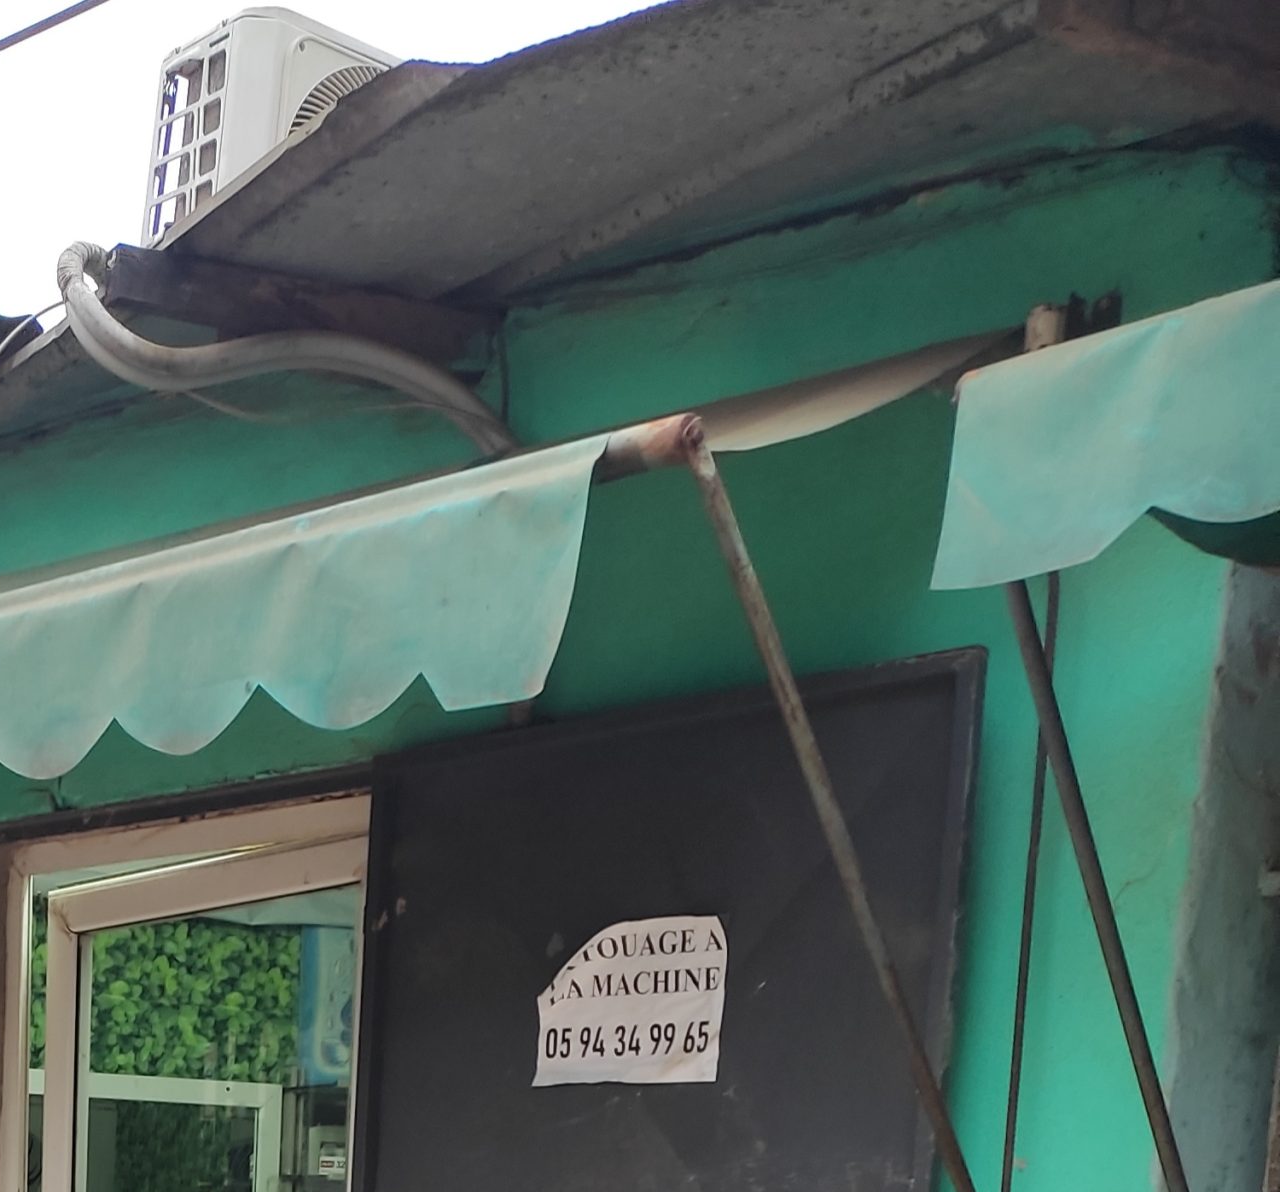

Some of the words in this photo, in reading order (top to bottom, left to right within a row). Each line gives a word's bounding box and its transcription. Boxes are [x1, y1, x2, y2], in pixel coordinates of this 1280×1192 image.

[592, 967, 720, 997] MACHINE
[545, 1028, 573, 1059] 05
[580, 1026, 605, 1058] 94
[614, 1025, 641, 1057] 34
[650, 1023, 676, 1055] 99
[683, 1020, 710, 1054] 65
